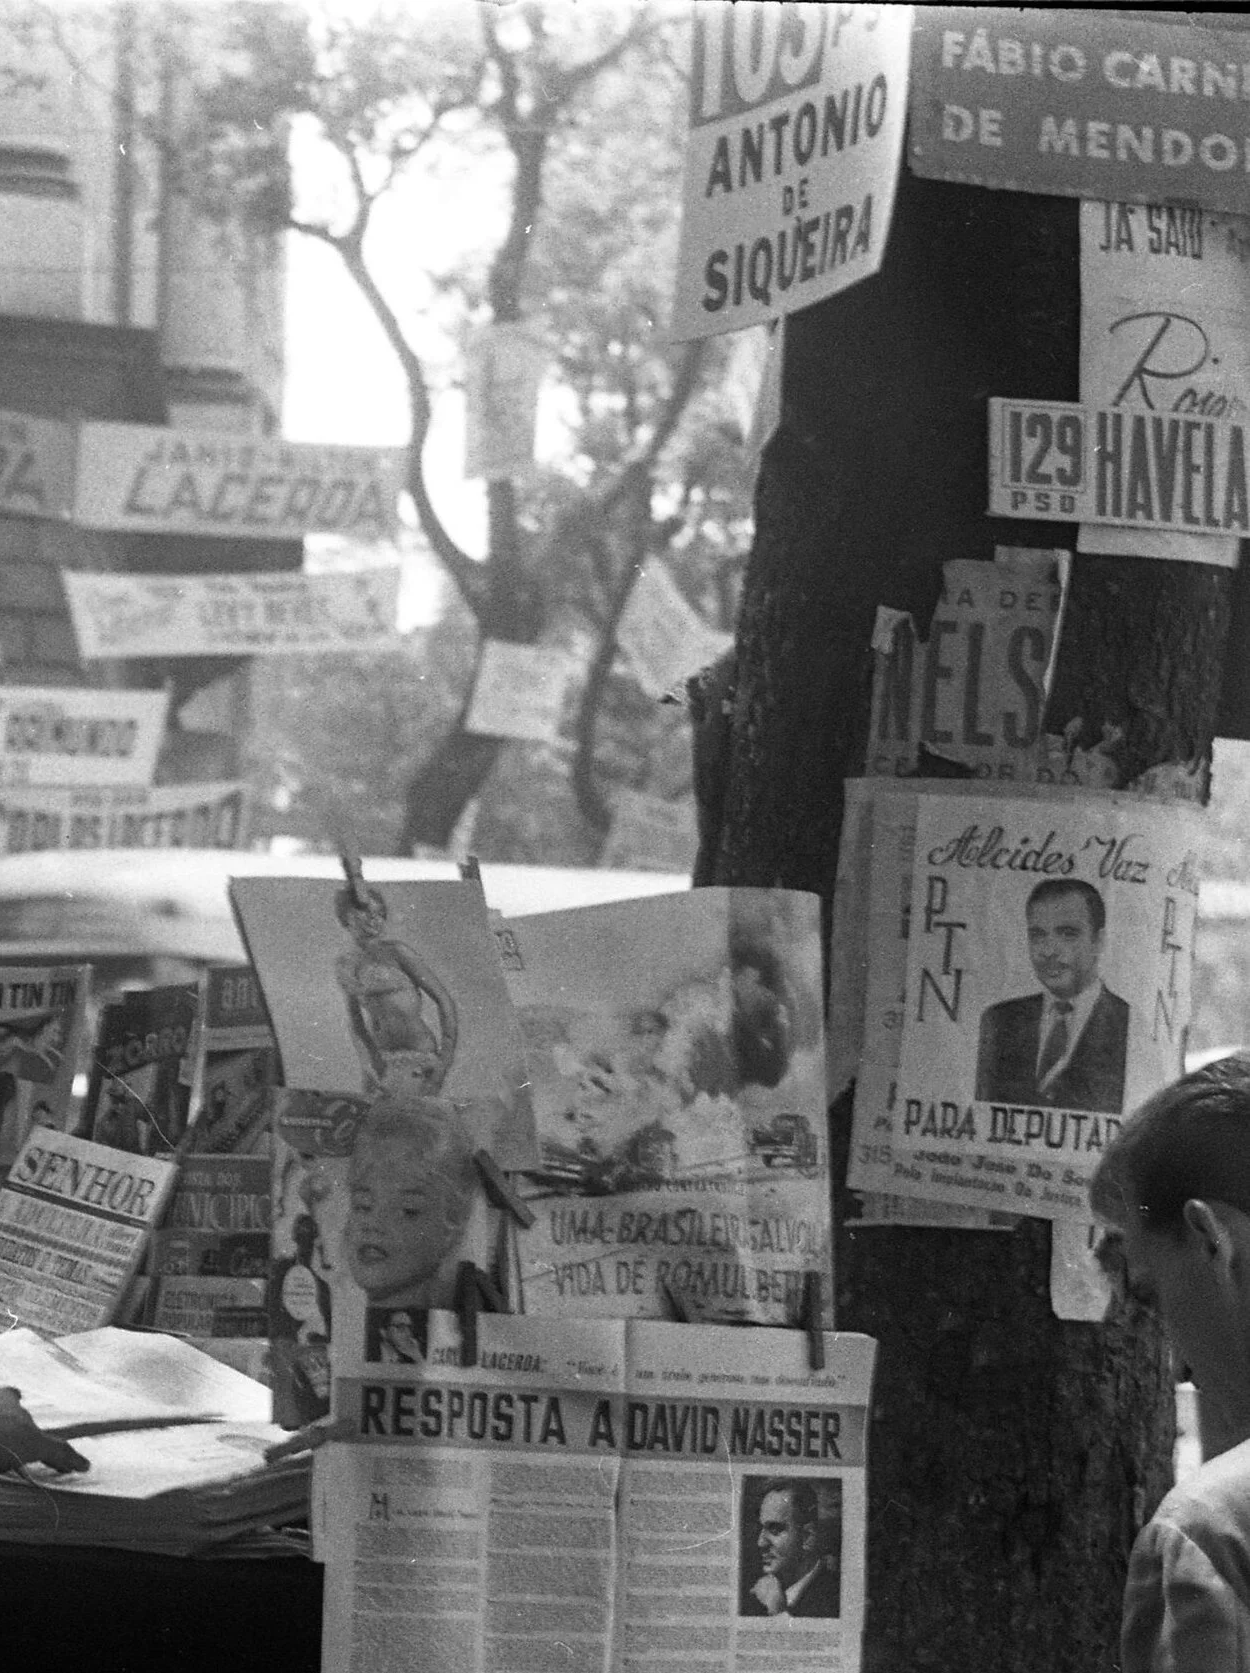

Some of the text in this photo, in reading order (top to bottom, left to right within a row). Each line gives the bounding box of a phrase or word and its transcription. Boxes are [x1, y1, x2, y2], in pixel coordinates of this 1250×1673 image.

[941, 27, 1250, 100] FÁBIO CARN
[705, 71, 887, 198] ANTONIO
[941, 103, 1250, 173] DE MENDO
[782, 176, 809, 216] DE
[702, 193, 873, 312] SIQUEIRA
[1009, 411, 1083, 487] 129
[124, 470, 386, 528] LACERDA
[1010, 492, 1077, 514] PSD
[927, 824, 1075, 876] Alcides
[9, 981, 45, 1009] TIN
[903, 1098, 976, 1142] PARA
[16, 1145, 156, 1217] SENHOR
[616, 1260, 645, 1295] DE
[360, 1383, 843, 1460] RESPOSTA A DAVID NASSER
